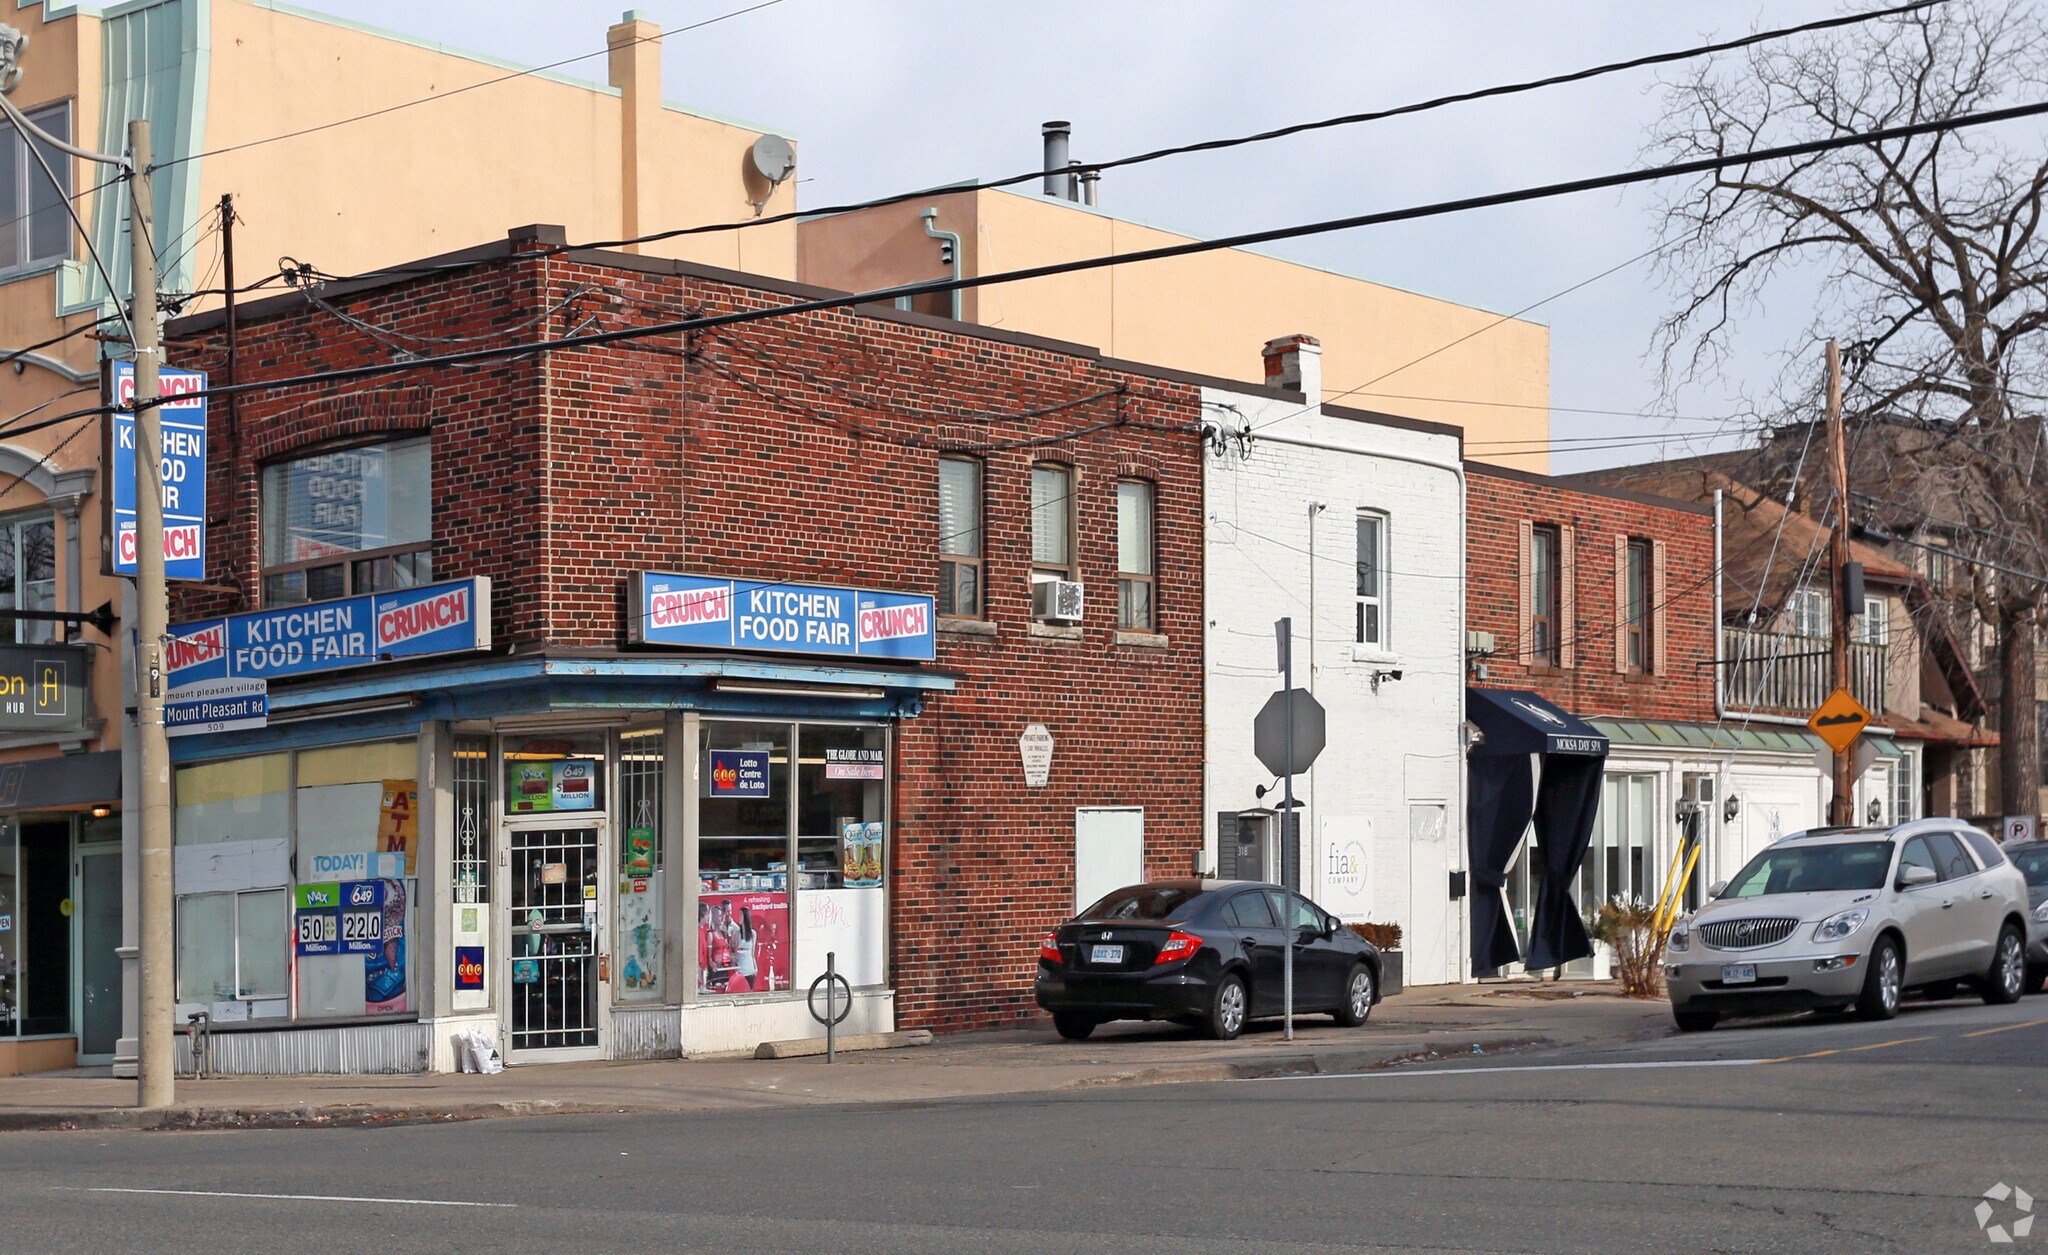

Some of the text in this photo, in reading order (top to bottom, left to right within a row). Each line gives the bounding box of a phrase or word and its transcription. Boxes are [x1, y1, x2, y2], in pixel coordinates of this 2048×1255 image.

[120, 377, 198, 406] CNCH
[120, 424, 200, 457] KHEN
[652, 589, 726, 625] CRUNCH
[750, 589, 840, 619] KITCHEN
[379, 591, 466, 643] CRUNCH
[860, 607, 926, 639] CRUNCH
[247, 606, 353, 644] KITCHEN
[740, 615, 850, 645] FOOD FAIR
[167, 629, 221, 671] UNCH
[236, 632, 365, 672] FOOD FAIR
[167, 682, 265, 700] mount pleasant village
[6, 701, 25, 714] HUB
[167, 700, 263, 722] Mount Pleasant Rd
[207, 722, 225, 732] 509
[1556, 739, 1601, 752] MOKSA DAY SPA
[826, 749, 883, 761] THE GLOBE AND MAIL
[739, 758, 758, 768] Lotto
[713, 769, 737, 781] OLG
[739, 769, 762, 779] Centre
[834, 766, 876, 777] On Sale here
[739, 780, 765, 789] de Loto
[386, 791, 410, 852] ATM
[1238, 846, 1249, 856] 318
[313, 854, 364, 872] TODAY!
[1328, 876, 1358, 884] COMPANY
[305, 943, 327, 952] Million
[348, 941, 371, 950] Million
[458, 963, 483, 976] OLG
